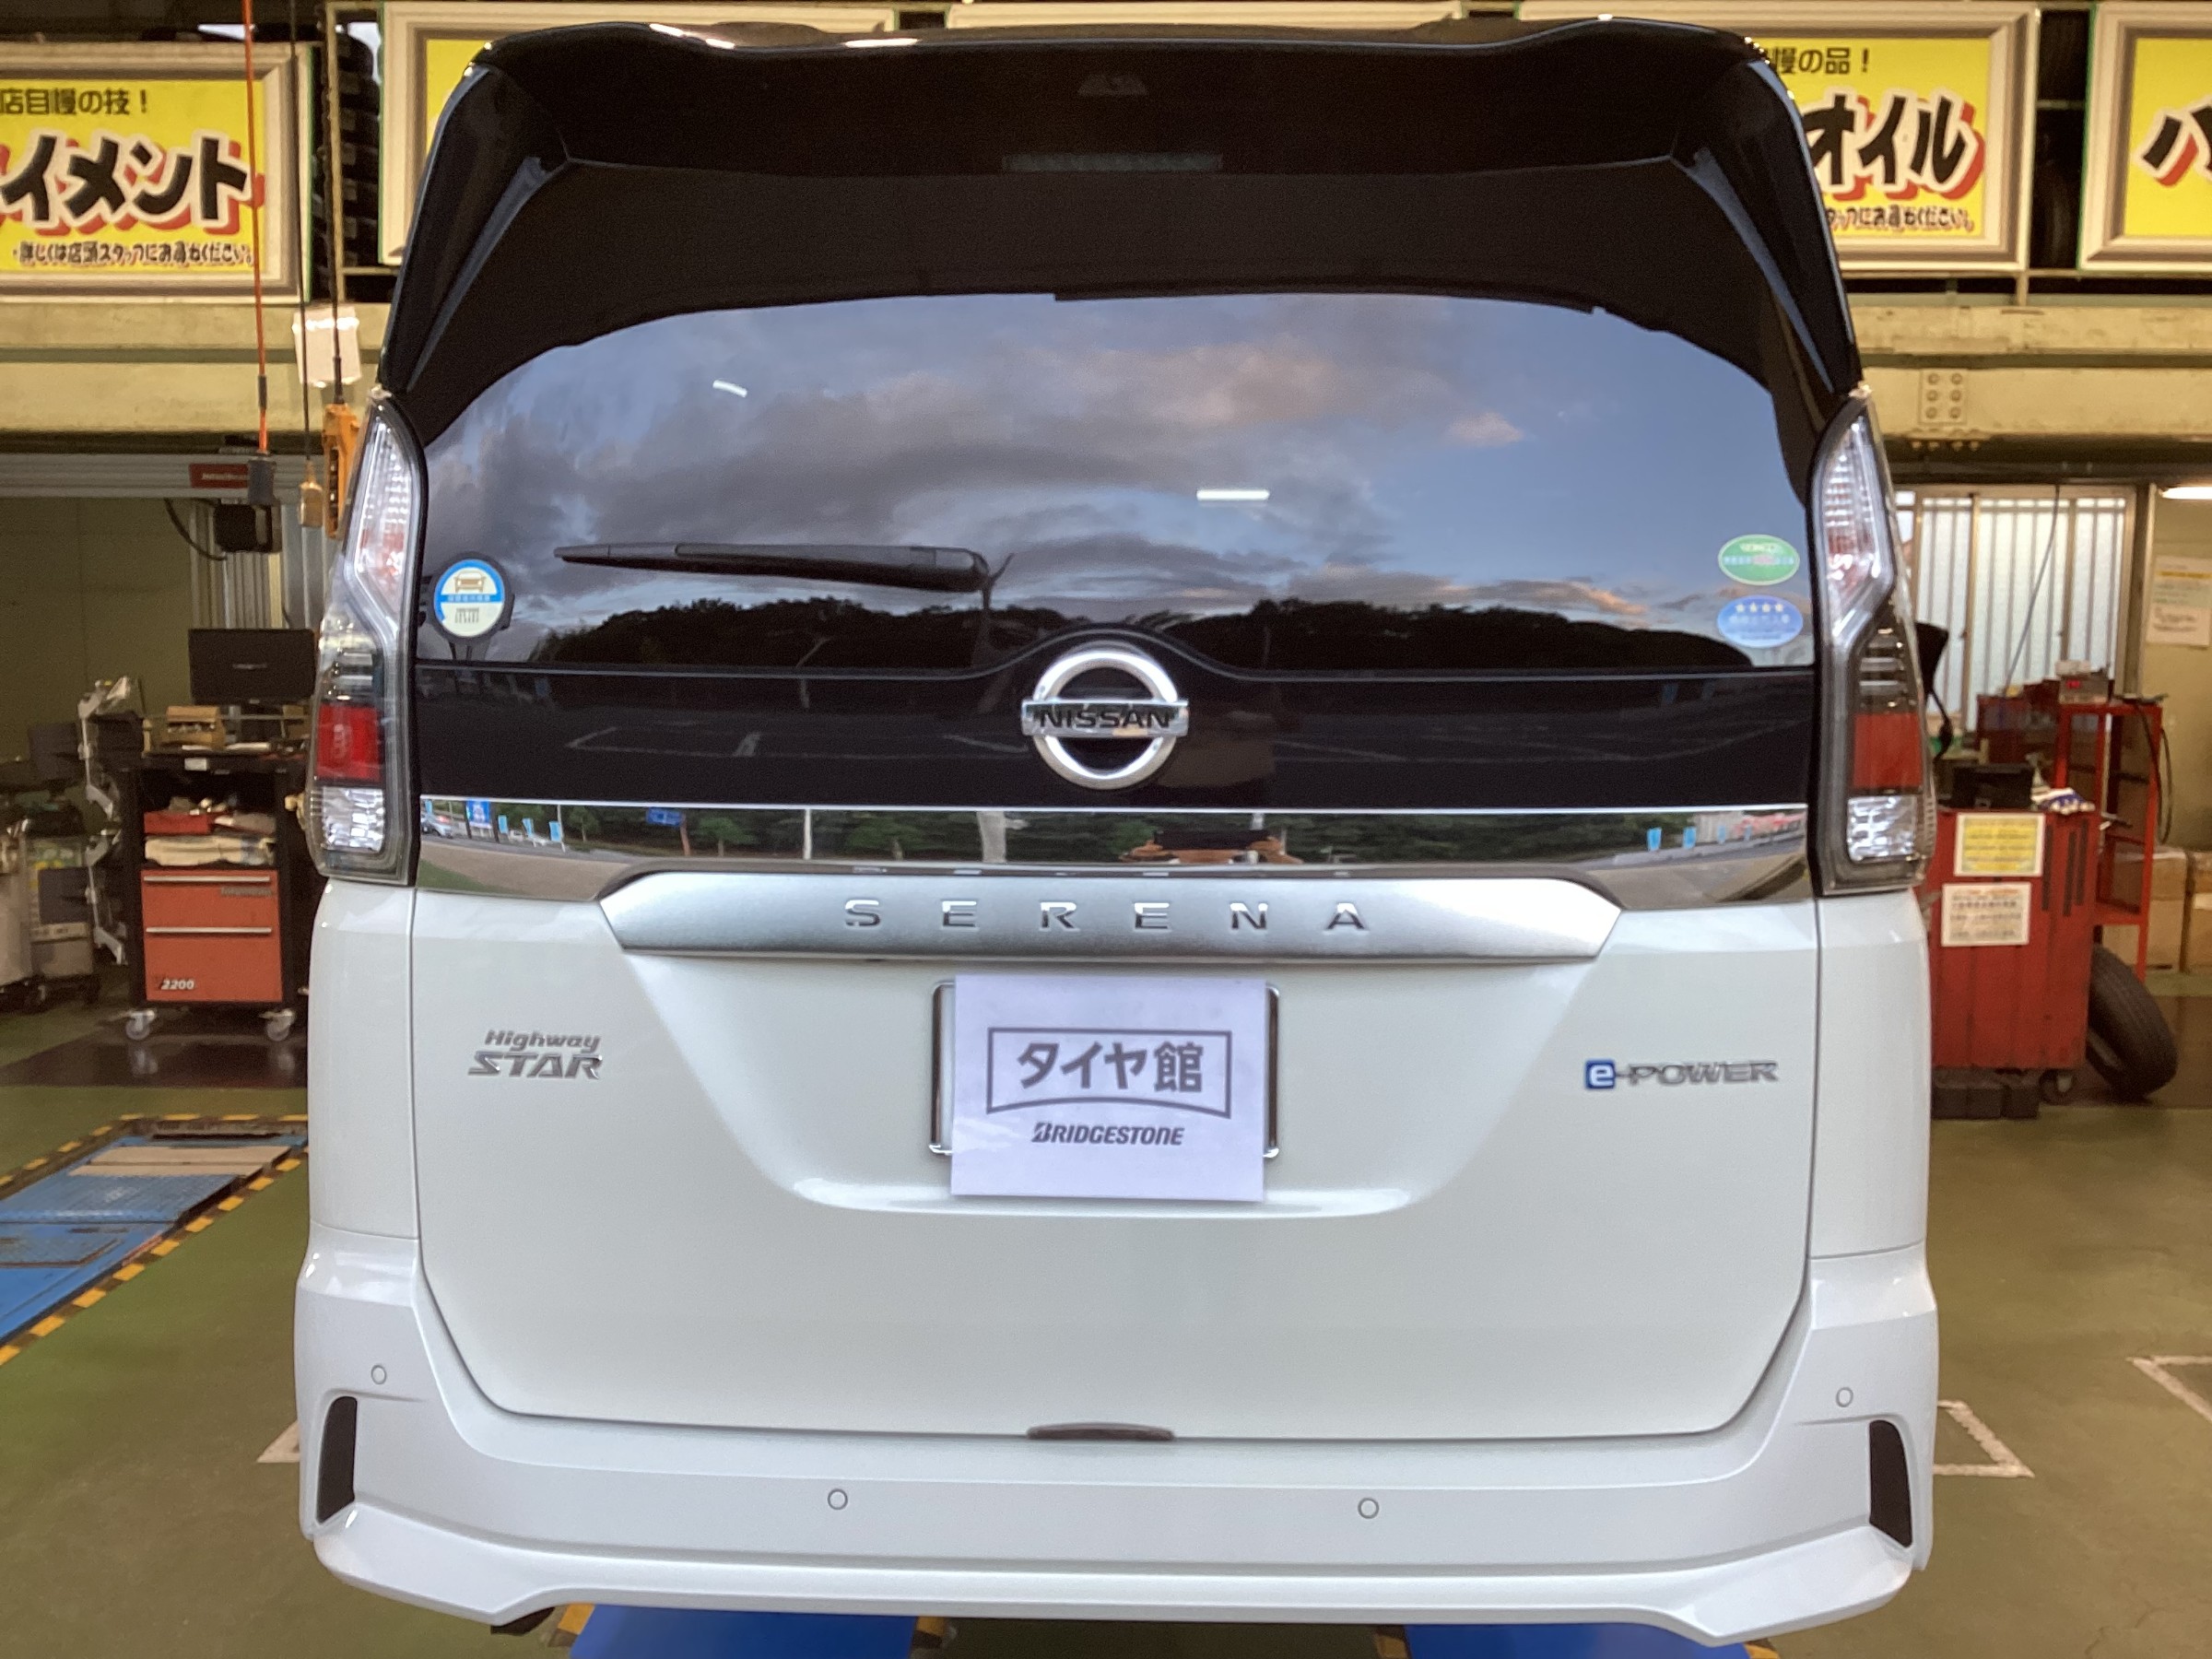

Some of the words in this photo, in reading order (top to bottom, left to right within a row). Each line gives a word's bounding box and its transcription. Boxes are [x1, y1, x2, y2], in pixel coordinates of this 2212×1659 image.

[1803, 94, 1967, 185] オイル
[1, 135, 247, 221] イメント
[1035, 708, 1171, 729] NISSAN
[844, 899, 1370, 932] SERENA
[485, 1030, 600, 1053] Highway
[468, 1051, 603, 1079] STAR
[1017, 1041, 1204, 1093] タイヤ館
[1031, 1122, 1185, 1146] BRIDGESTONE
